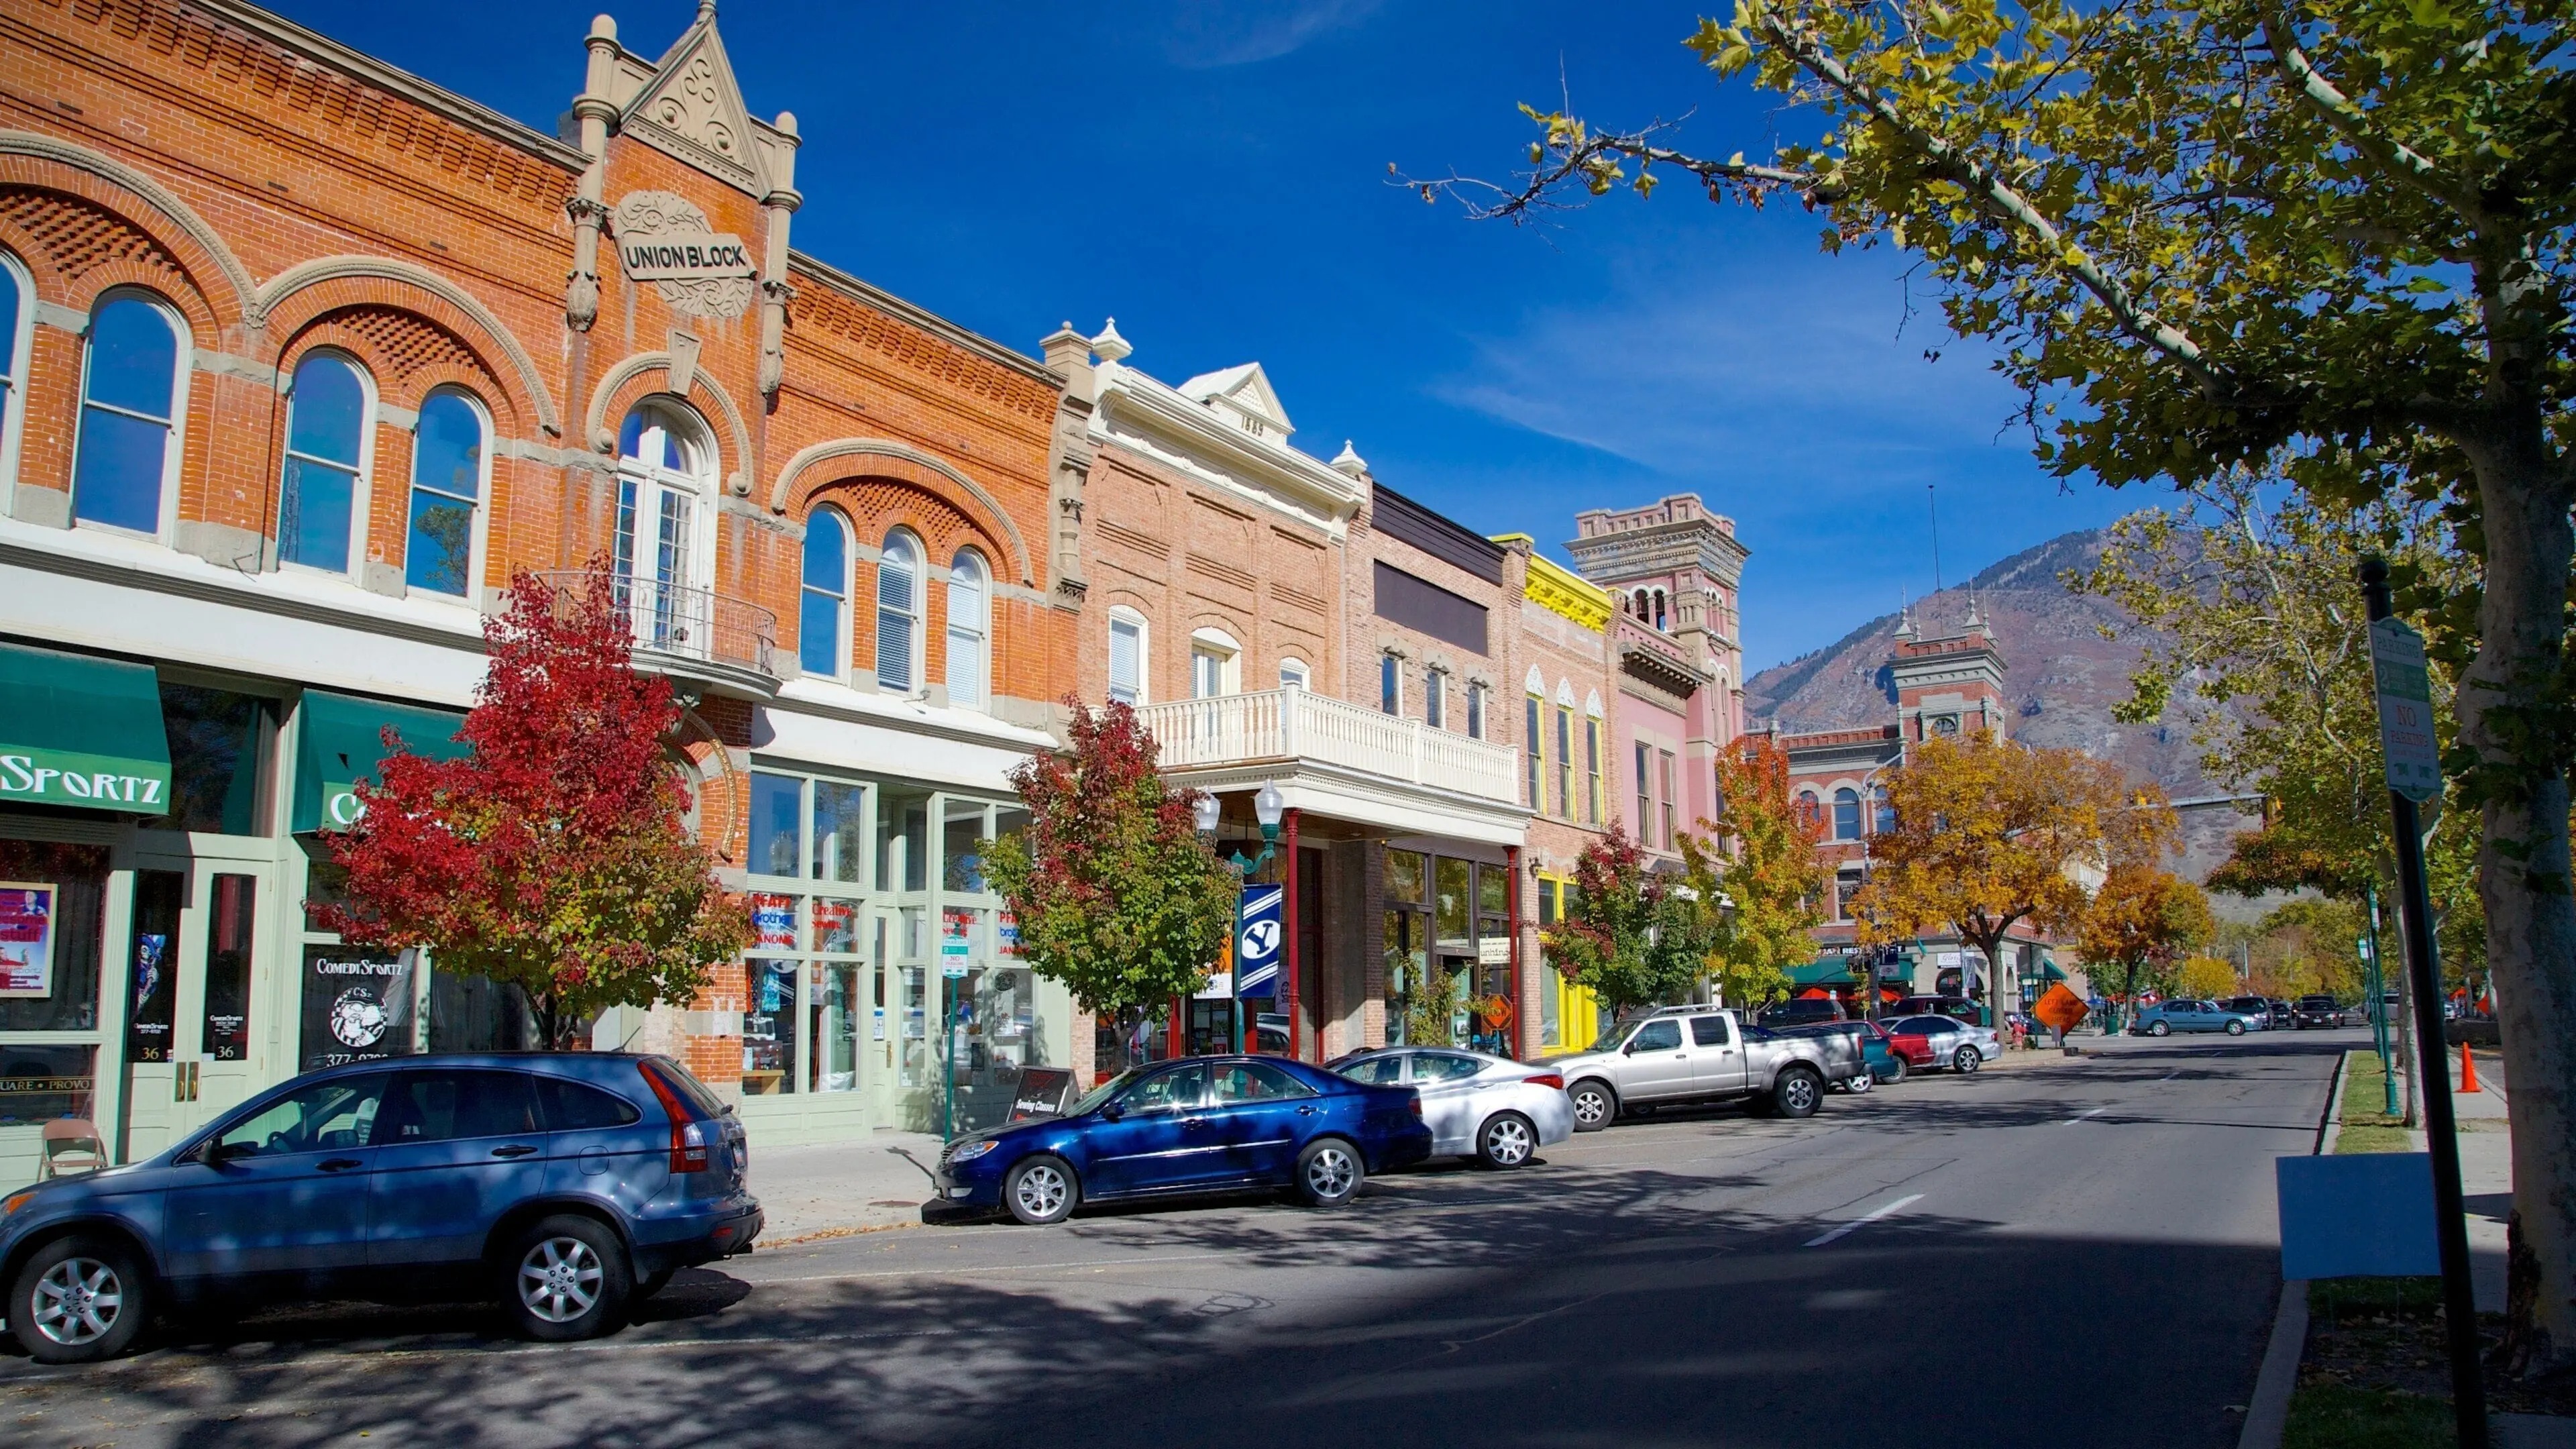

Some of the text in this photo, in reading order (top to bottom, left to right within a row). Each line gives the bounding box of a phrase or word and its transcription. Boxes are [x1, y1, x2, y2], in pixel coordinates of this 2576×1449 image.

[625, 246, 747, 269] UNION BLOCK
[1241, 415, 1264, 437] 1889
[2377, 635, 2419, 658] PARKING
[2396, 704, 2416, 727] NO
[2390, 730, 2428, 747] PARKING
[0, 755, 162, 804] SPORTZ
[812, 903, 853, 916] Creative
[0, 916, 46, 924] esome
[1000, 912, 1018, 923] PFA
[1, 928, 41, 941] stuff
[1244, 923, 1273, 955] Y
[142, 1047, 159, 1059] 36
[217, 1046, 234, 1058] 36
[0, 1080, 90, 1091] UARE PROVO
[1016, 1099, 1055, 1113] Sewing Classes
